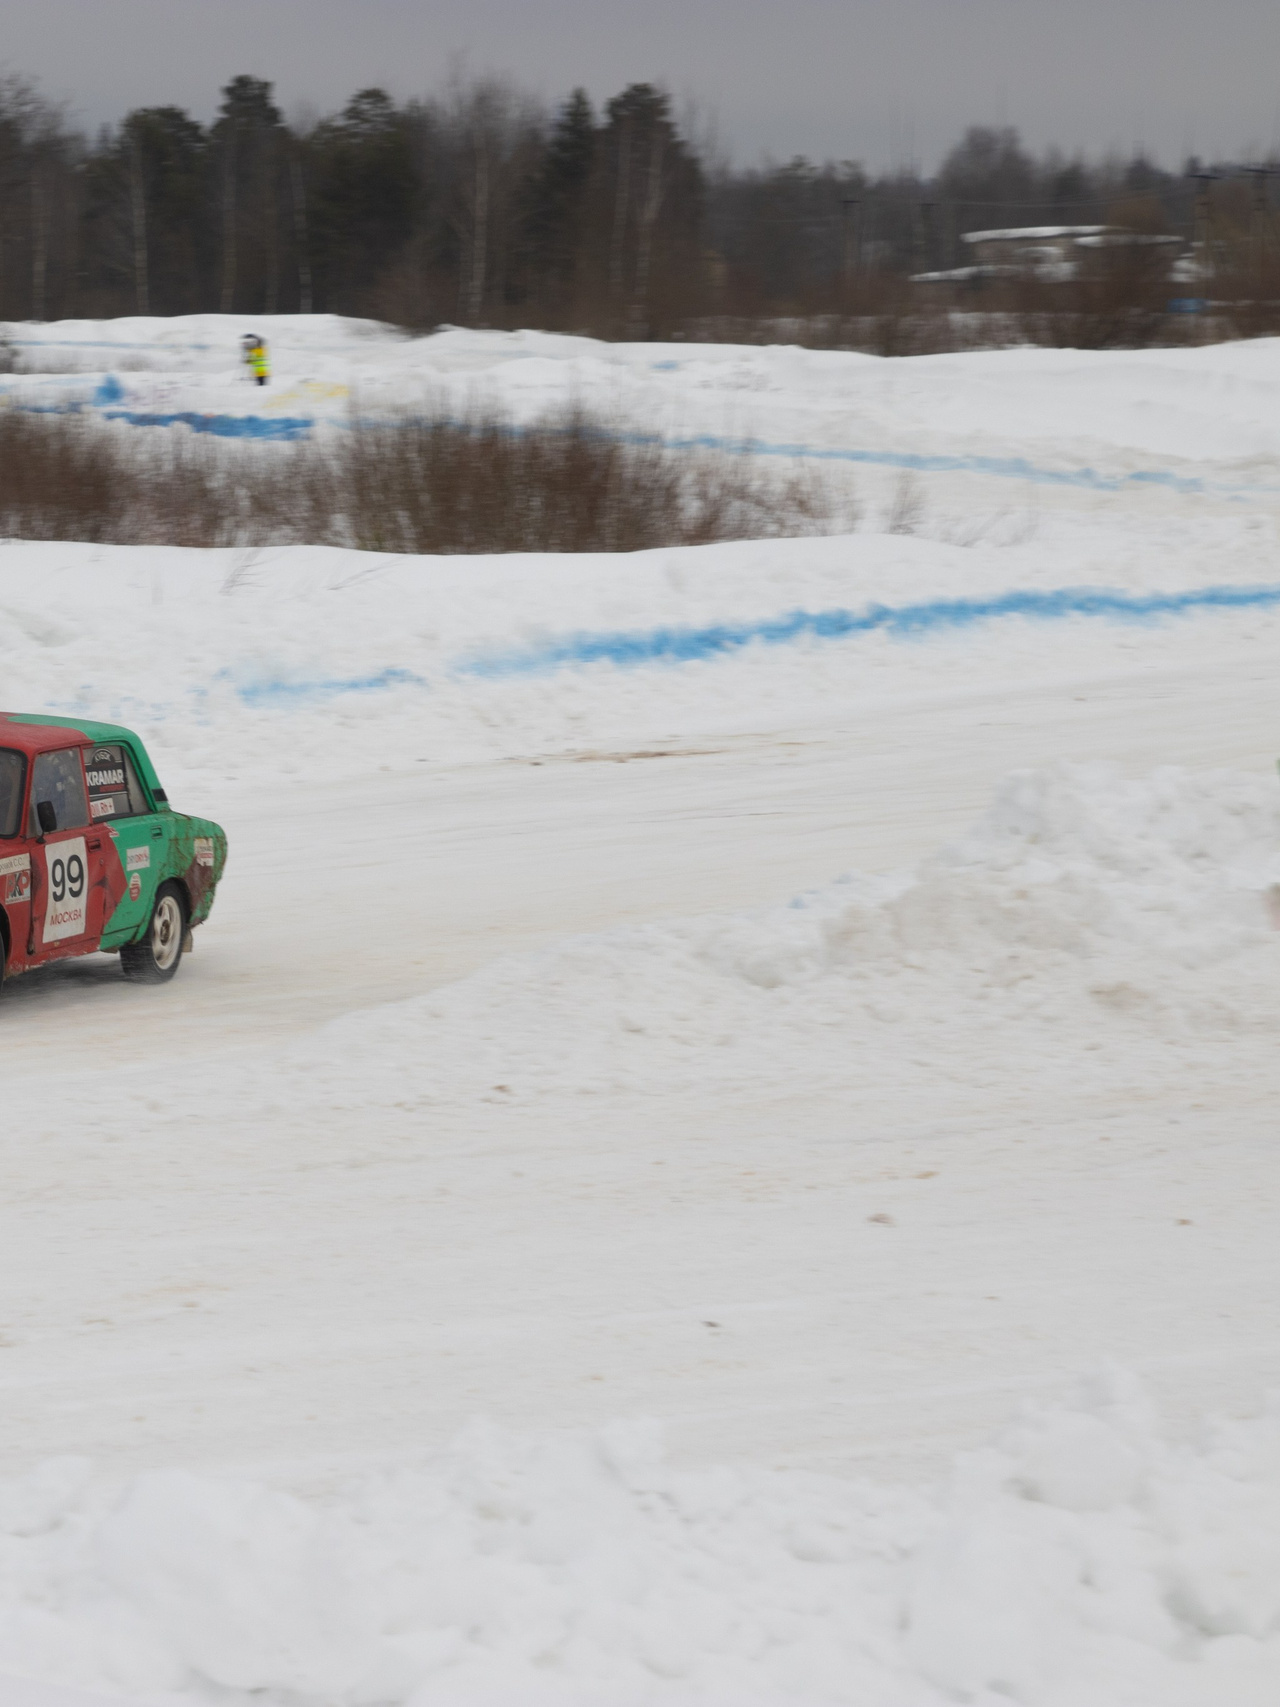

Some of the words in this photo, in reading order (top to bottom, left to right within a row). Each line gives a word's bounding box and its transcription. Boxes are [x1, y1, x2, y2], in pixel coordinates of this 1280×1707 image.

[86, 769, 124, 786] KRAMAR
[52, 855, 84, 902] 99
[50, 909, 82, 926] МОСКВА
